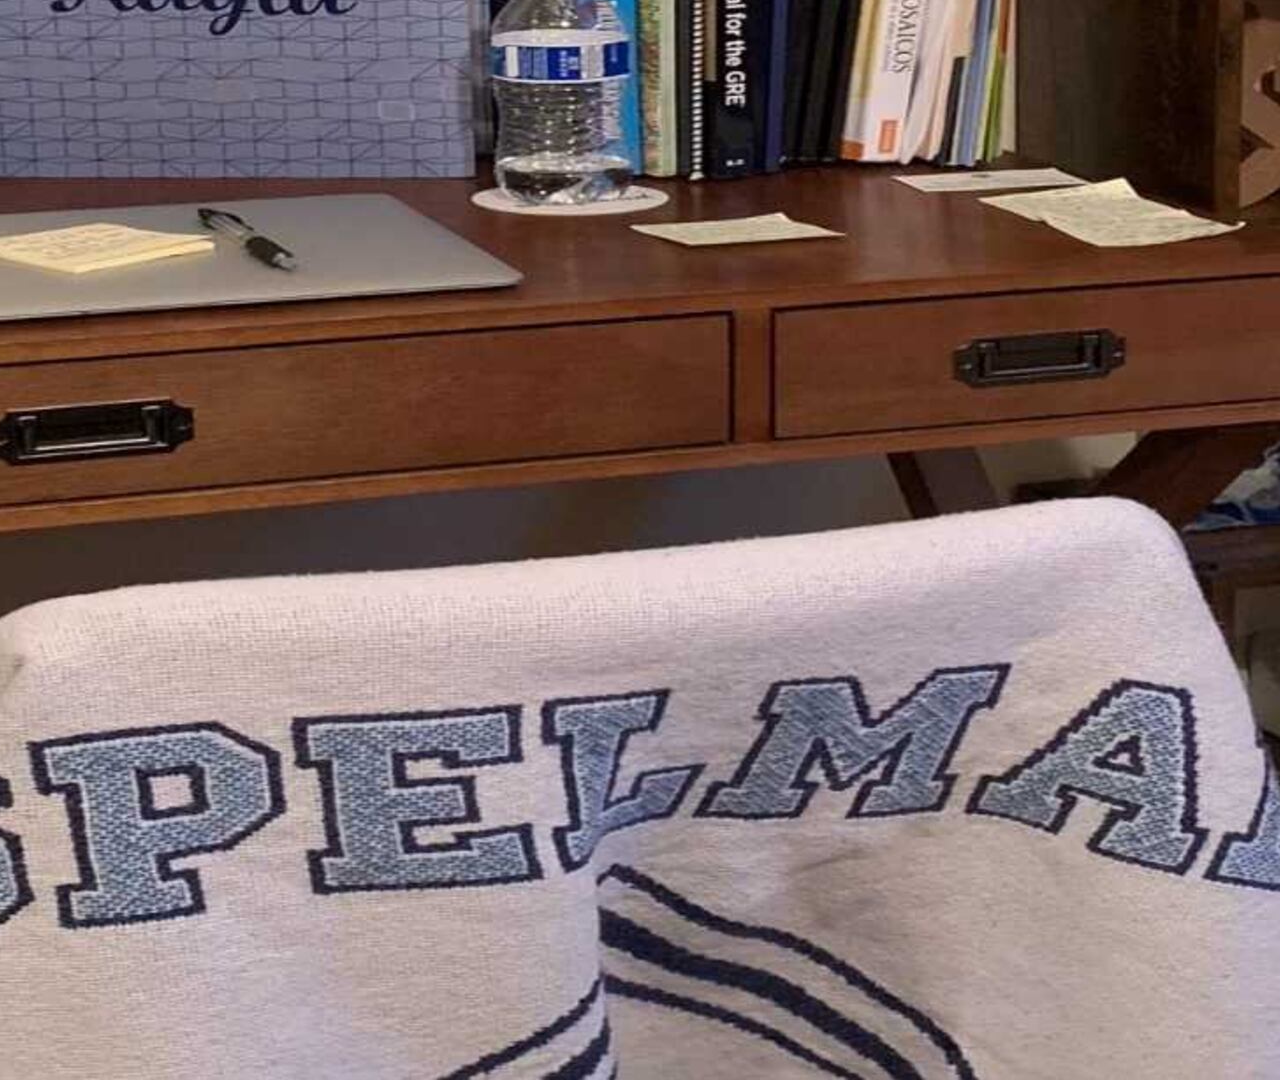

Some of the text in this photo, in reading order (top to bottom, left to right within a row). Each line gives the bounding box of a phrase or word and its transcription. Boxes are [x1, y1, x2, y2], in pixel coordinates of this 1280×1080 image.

[725, 12, 747, 37] for
[725, 39, 746, 68] the
[724, 69, 746, 106] GRE
